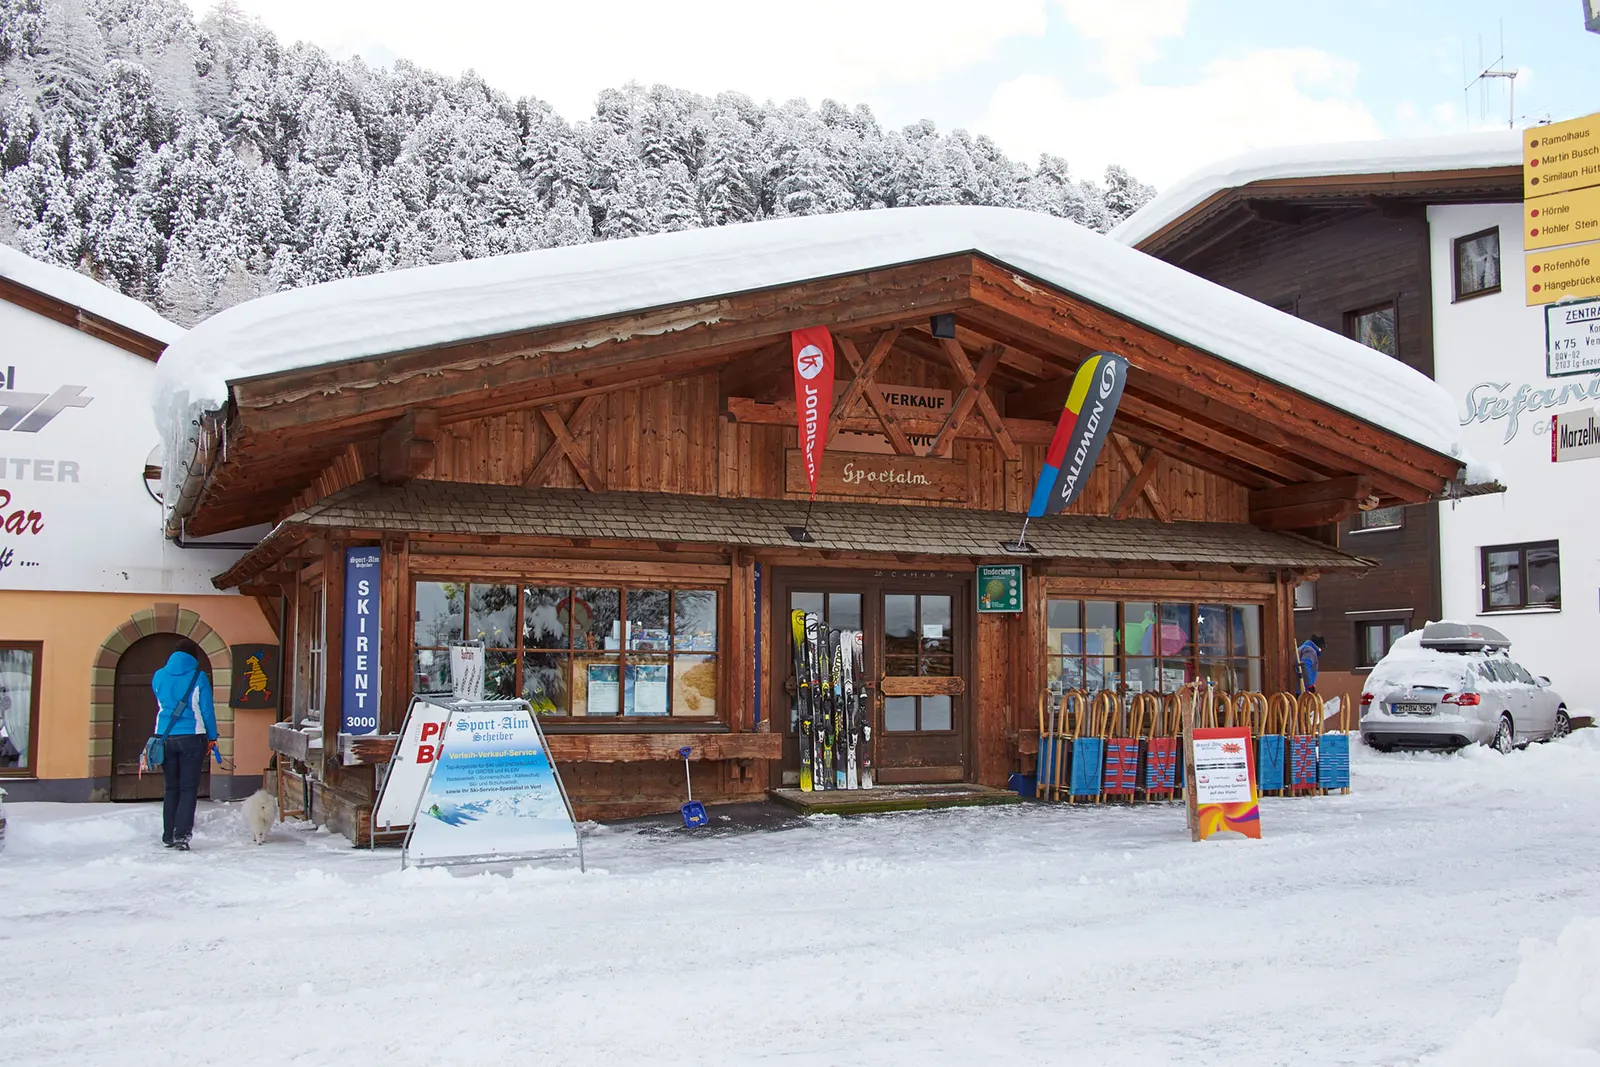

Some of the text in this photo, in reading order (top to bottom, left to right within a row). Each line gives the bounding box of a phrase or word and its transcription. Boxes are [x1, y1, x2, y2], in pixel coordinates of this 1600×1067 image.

[1541, 130, 1590, 146] Ramolhaus
[1542, 146, 1599, 165] Martin Busch
[1542, 170, 1578, 183] Similaun
[1542, 205, 1570, 216] Hörnle
[1542, 219, 1599, 235] Hohler Stein
[1543, 257, 1590, 272] Rofenhöfe
[1554, 340, 1561, 350] K
[1564, 338, 1576, 349] 75
[881, 392, 945, 409] VERKAUF
[1061, 400, 1105, 503] SALOMON
[843, 462, 931, 485] Sportalm
[983, 568, 1016, 577] Underberg
[346, 716, 376, 727] 3000
[472, 732, 514, 743] Scheiber
[449, 749, 537, 760] Verleih-Verkauf-Service
